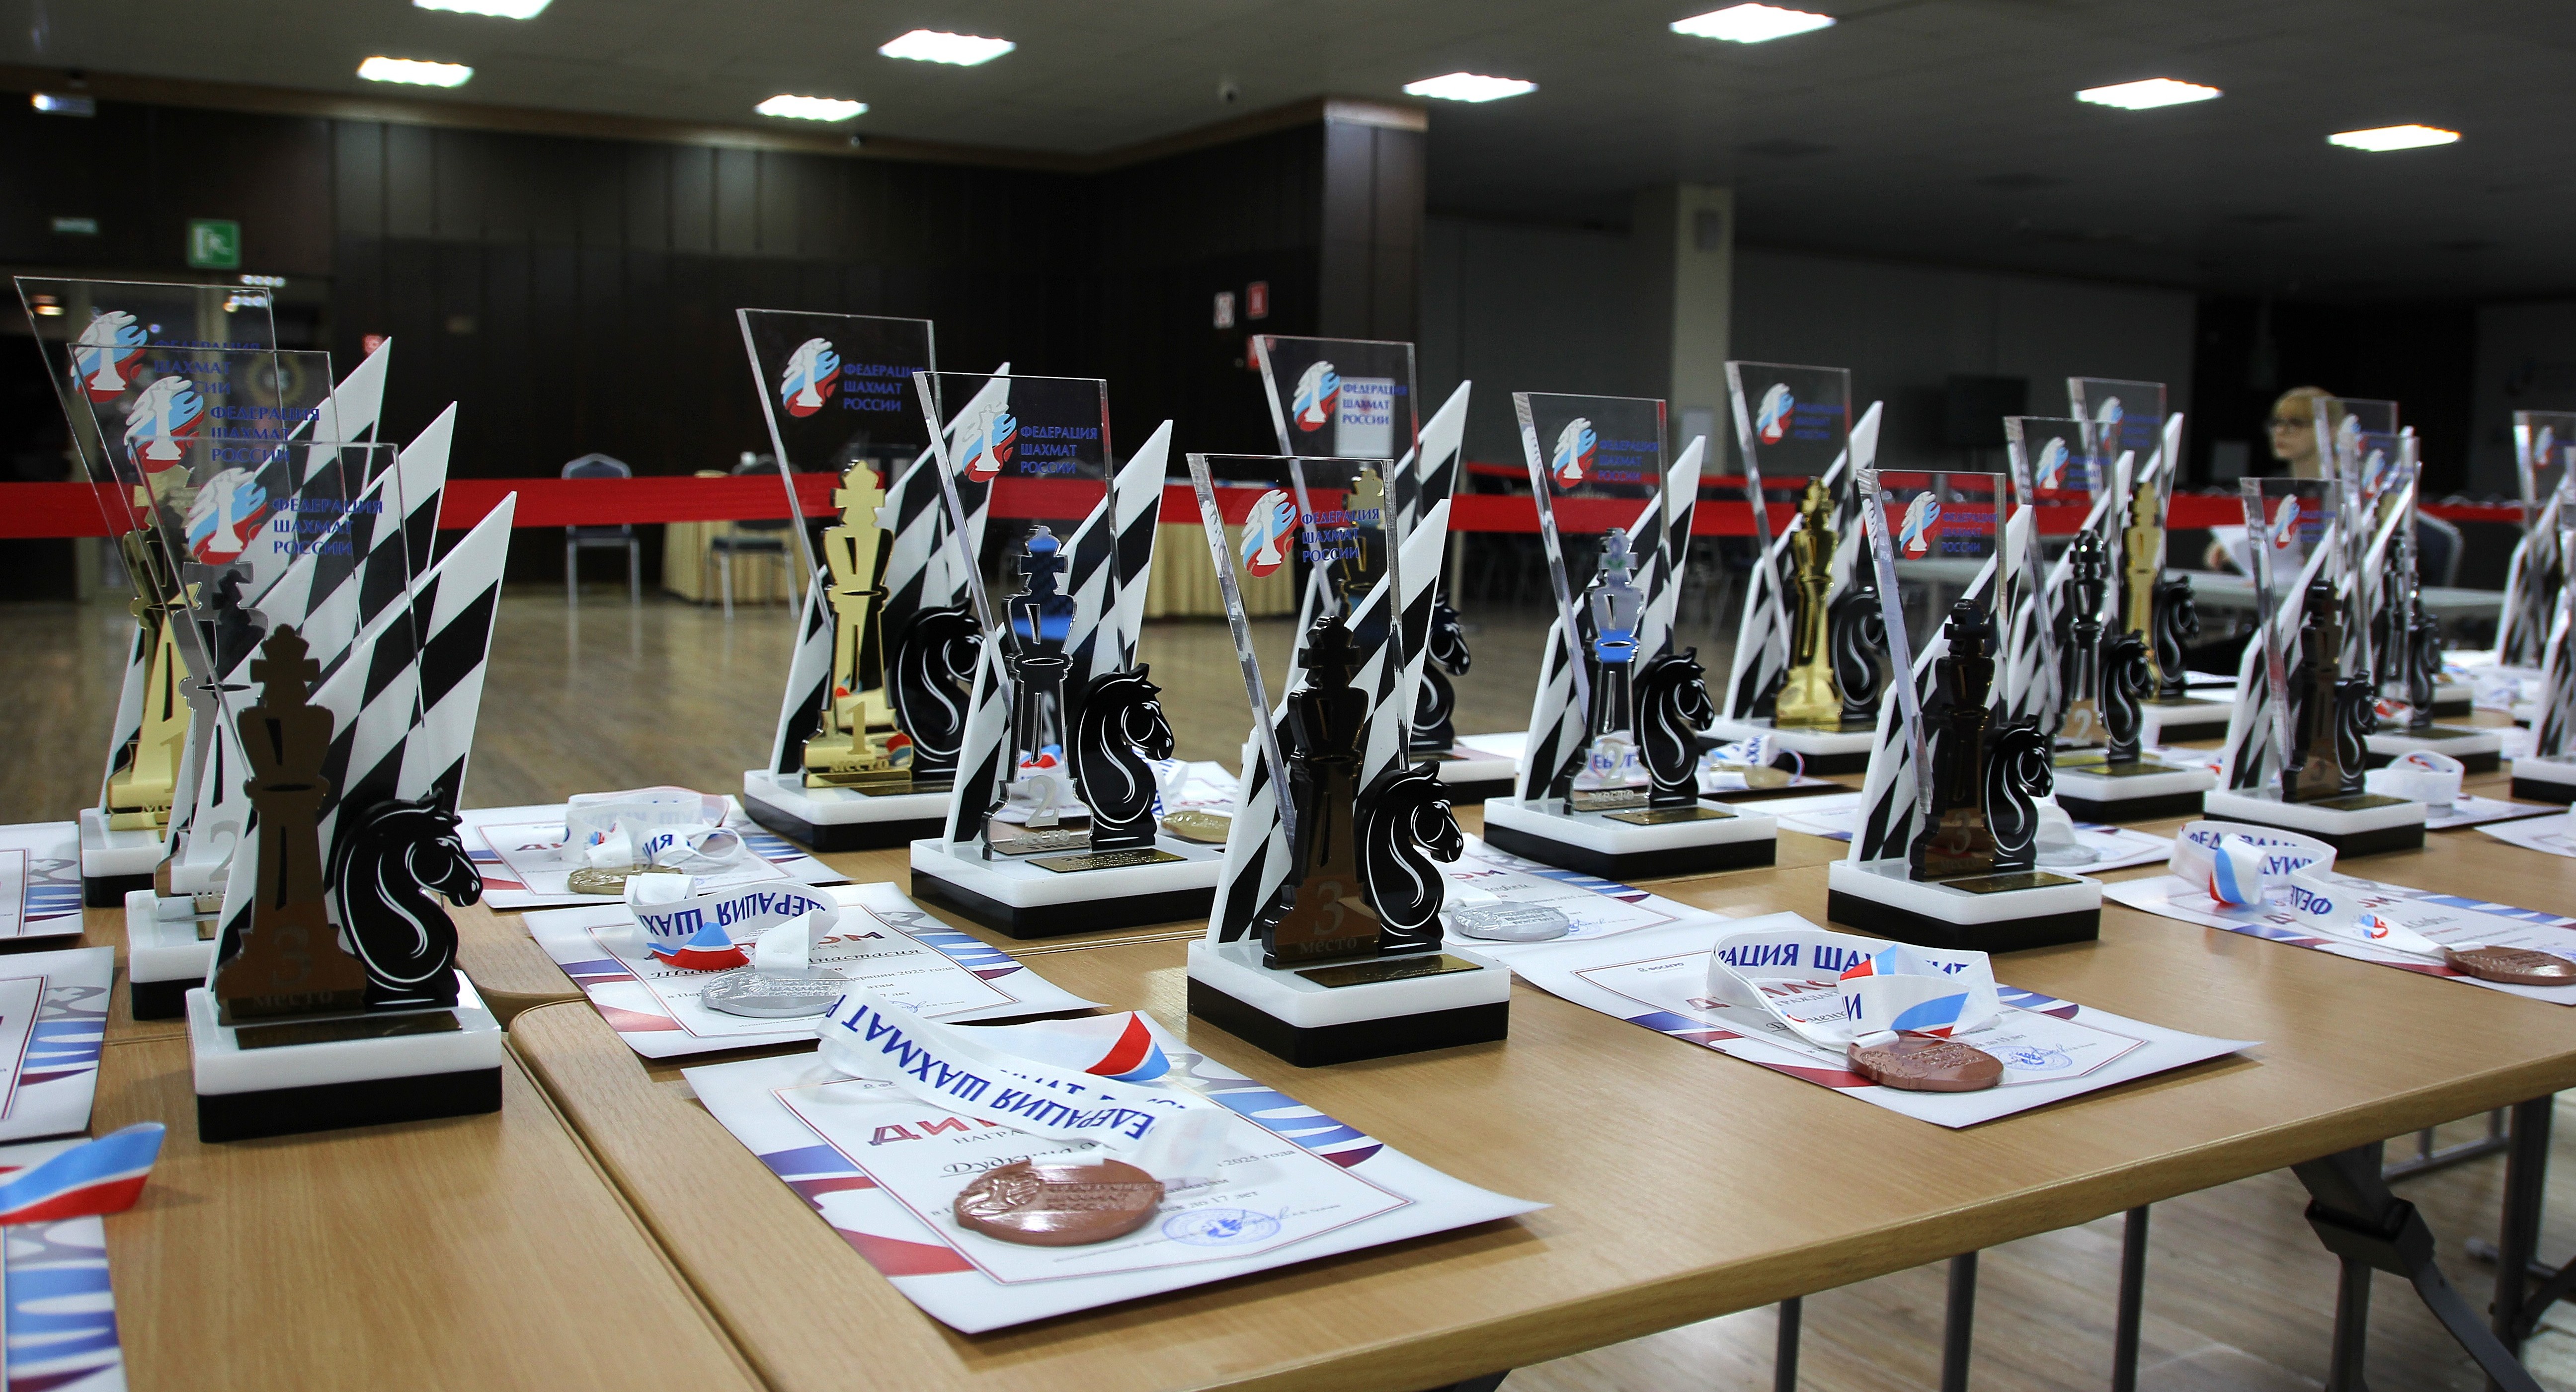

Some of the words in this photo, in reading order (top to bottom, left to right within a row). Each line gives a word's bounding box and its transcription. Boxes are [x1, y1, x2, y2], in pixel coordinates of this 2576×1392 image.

[844, 381, 902, 395] ШАХМАТ
[844, 398, 901, 412] РОССИИ
[210, 406, 320, 421] ФЕДЕРАЦИЯ
[1343, 413, 1389, 424] РОССИИ
[1021, 426, 1098, 439] ФЕДЕРАЦИЯ
[211, 447, 290, 463] РОССИИ
[1021, 443, 1077, 456] ШАХМАТ
[1021, 461, 1076, 474] РОССИИ
[273, 498, 383, 514] ФЕДЕРАЦИЯ
[1301, 508, 1379, 525] ФЕДЕРАЦИЯ
[274, 520, 354, 534] ШАХМАТ
[1302, 528, 1360, 544] ШАХМАТ
[274, 540, 353, 554] РОССИИ
[1303, 547, 1360, 563] РОССИИ
[845, 701, 871, 755] 1
[2073, 707, 2093, 747] 2
[1601, 743, 1626, 787] 2
[1025, 775, 1059, 828] 2
[1314, 880, 1345, 935] 3
[897, 968, 925, 976] 2025
[841, 1004, 992, 1102] ШАХМАТ
[989, 1087, 1155, 1140] ЕДЕРАЦИЯ
[1223, 1156, 1260, 1166] 2025
